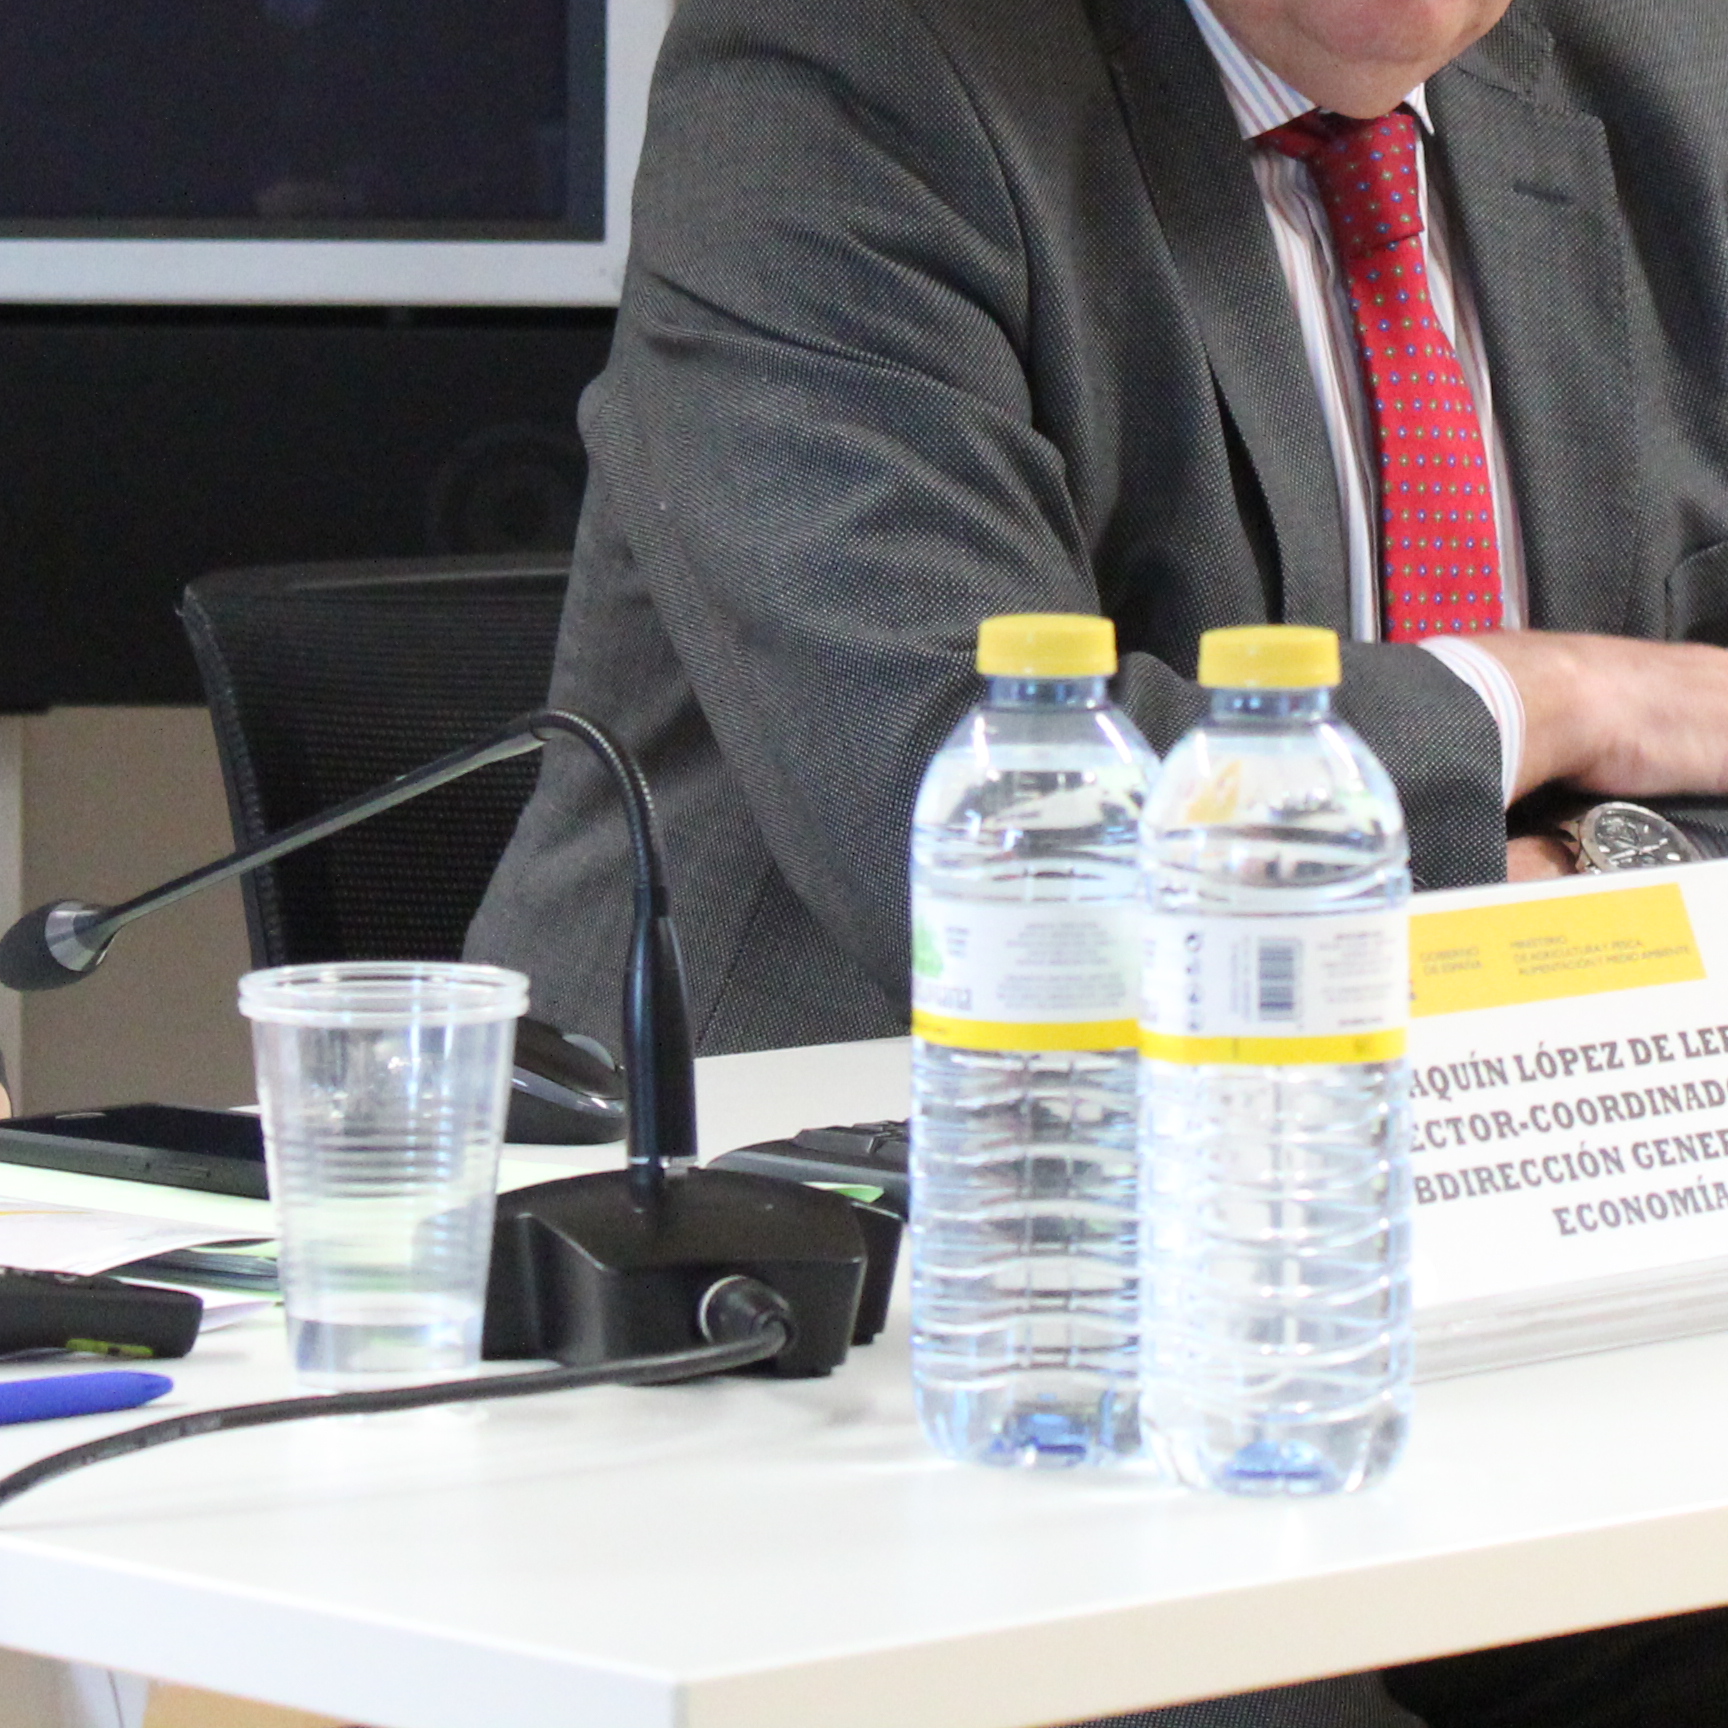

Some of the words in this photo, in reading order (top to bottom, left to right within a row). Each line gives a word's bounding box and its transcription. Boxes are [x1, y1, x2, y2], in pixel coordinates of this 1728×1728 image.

[1509, 934, 1568, 949] MINISTERIO
[1419, 945, 1480, 964] GOBIERNO
[1512, 952, 1528, 964] DE
[1530, 943, 1599, 962] AGRICULTURA
[1606, 951, 1639, 963] MEDIO
[1642, 944, 1691, 959] AMBIENTE
[1422, 962, 1439, 976] DE
[1441, 959, 1483, 974] ESPAÑA
[1408, 1049, 1510, 1102] AQUÍN
[1512, 1041, 1624, 1084] LÓPEZ
[1626, 1033, 1676, 1066] DE
[1413, 1140, 1626, 1206] BDIRECCIÓN
